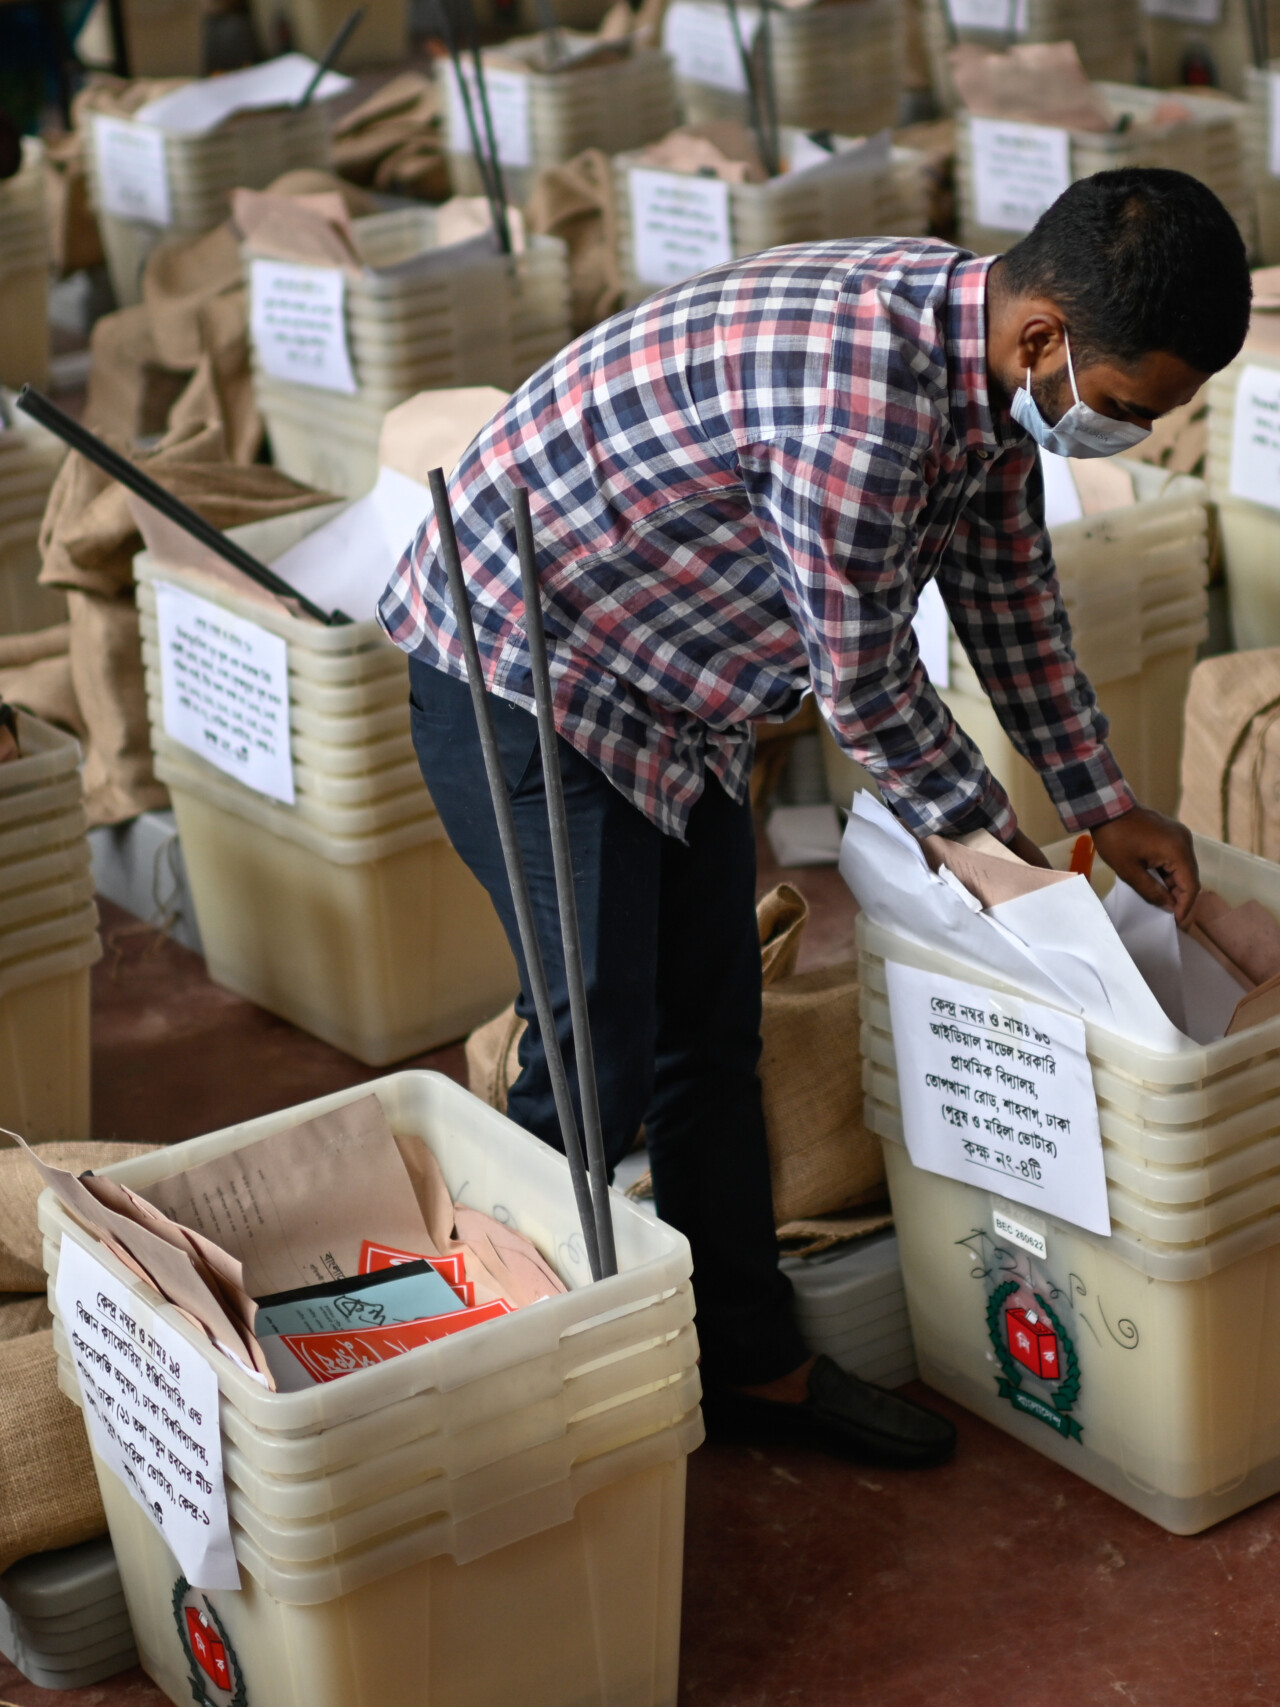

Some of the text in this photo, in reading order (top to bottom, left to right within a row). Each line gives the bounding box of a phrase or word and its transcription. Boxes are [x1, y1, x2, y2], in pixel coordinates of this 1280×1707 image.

[930, 996, 956, 1017] কেন্দ্র
[959, 1004, 985, 1025] নম্বর
[988, 1013, 1000, 1028] ও
[1002, 1015, 1030, 1037] নামঃ
[929, 1022, 1056, 1075] আইডিয়াল মডেল সরকারি
[950, 1055, 1039, 1100] প্রাথমিক বিদ্যালয়,
[925, 1073, 1071, 1134] তোপখানা রোড, শাহবাগ, ঢাকা
[941, 1104, 1058, 1159] (পুরুষ ও মহিলা ভোটার)
[961, 1138, 1042, 1181] কক্ষ নং-৪টি
[996, 1219, 1013, 1235] BEC
[96, 1291, 117, 1320] কেন্দ্র
[119, 1308, 137, 1337] নম্বর
[138, 1328, 146, 1344] ও
[147, 1334, 167, 1365] নামঃ
[75, 1300, 99, 1331] বিজ্ঞান
[188, 1407, 203, 1426] এন্ড
[132, 1416, 148, 1440] তলা
[149, 1431, 166, 1458] নতুন
[167, 1449, 193, 1484] ভবনের
[142, 1394, 160, 1419] ঢাকা
[161, 1407, 209, 1466] বিশ্ববিদ্যালয়,
[122, 1440, 146, 1470] মহিলা
[147, 1463, 176, 1505] ভোটার),
